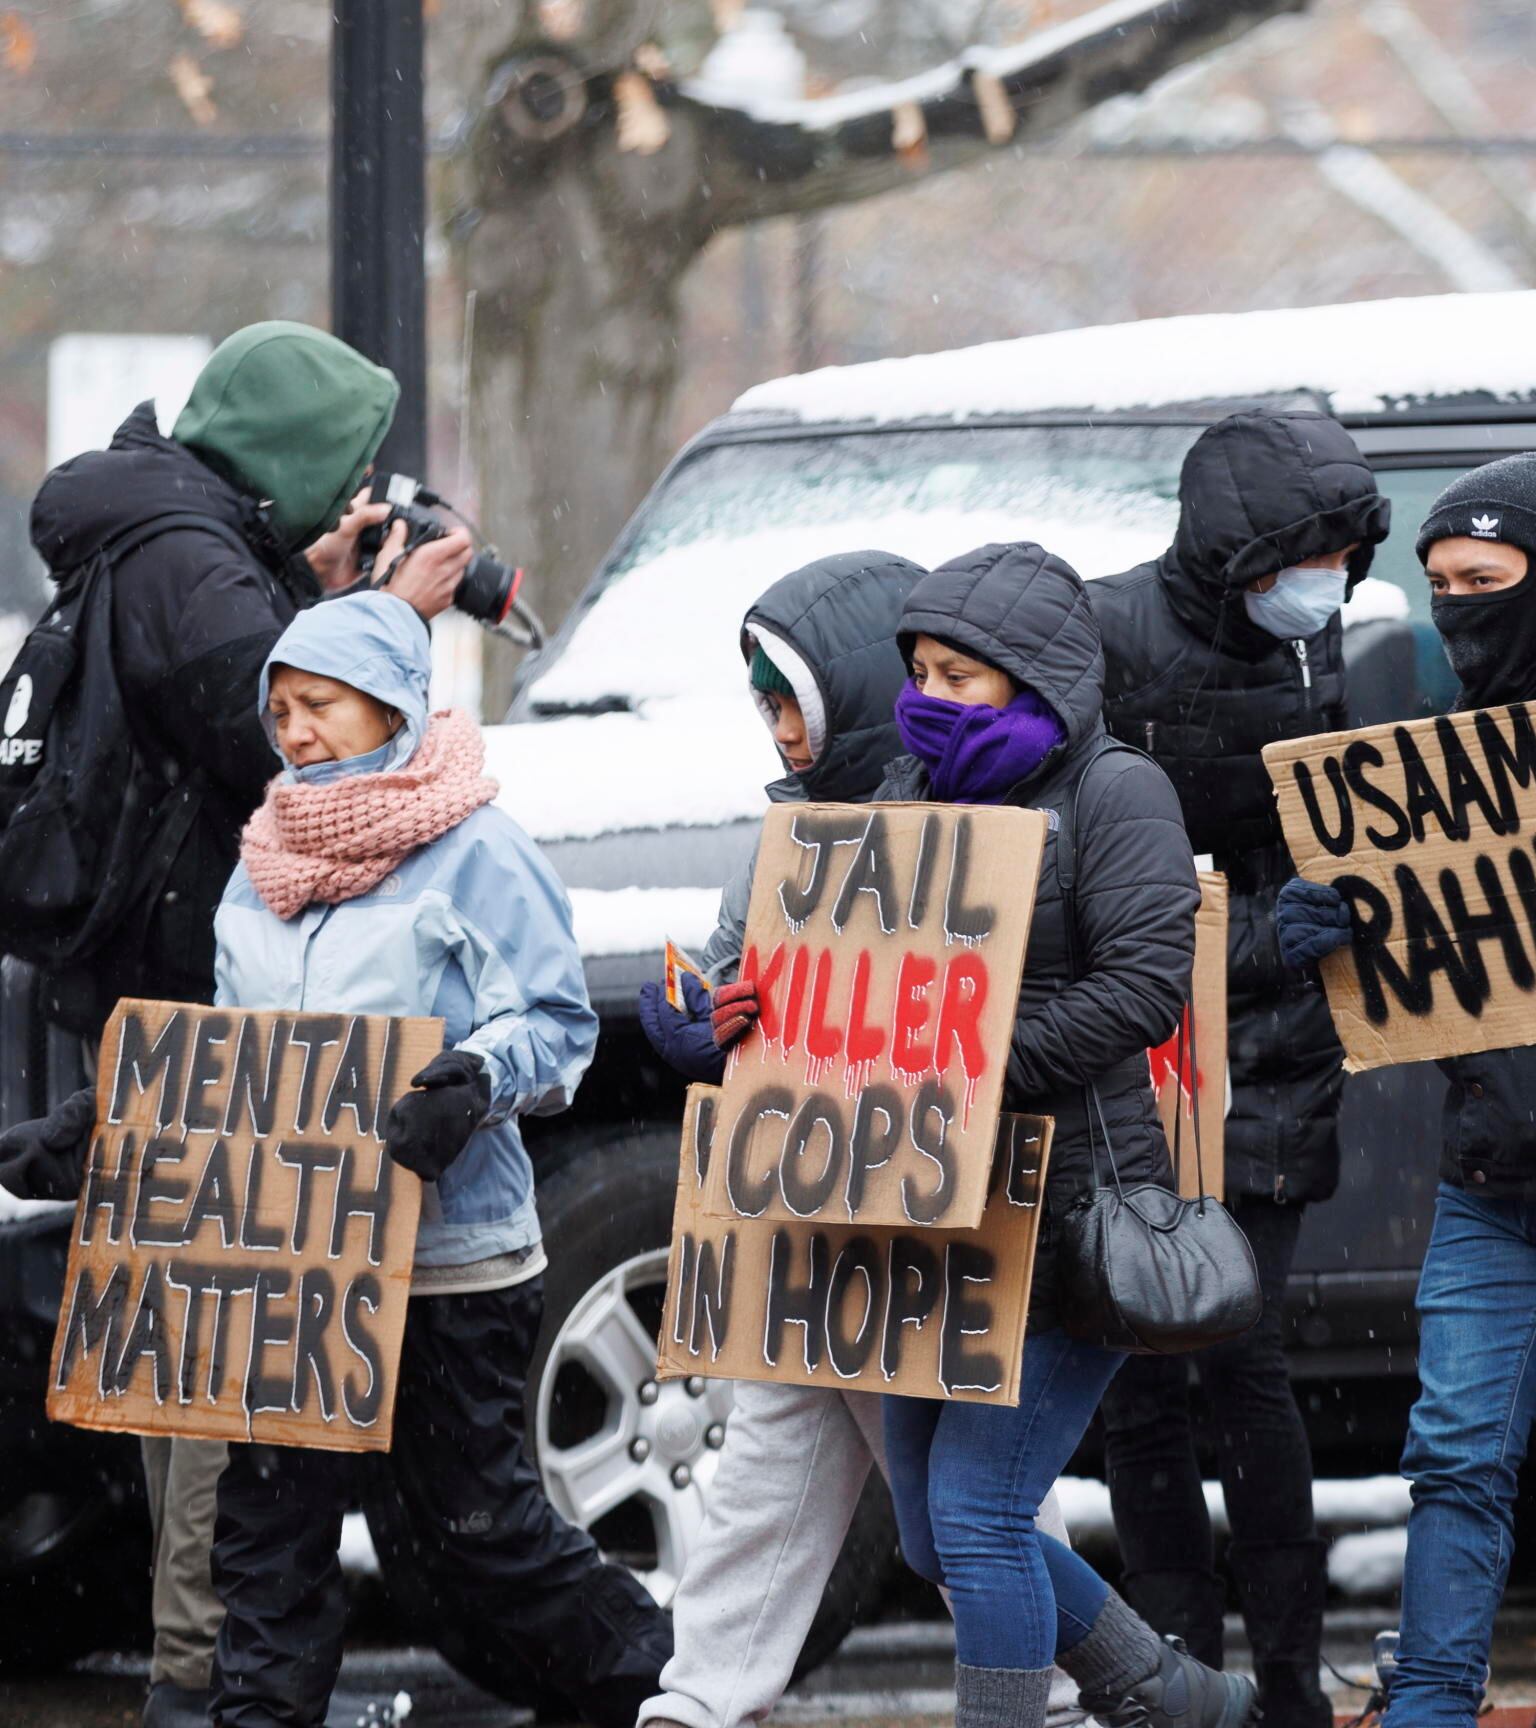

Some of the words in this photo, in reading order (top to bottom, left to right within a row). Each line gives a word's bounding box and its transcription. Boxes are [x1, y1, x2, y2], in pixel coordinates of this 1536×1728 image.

[778, 810, 996, 947] JAIL
[733, 942, 989, 1112] KILLER
[79, 1130, 392, 1266] HEALTH
[727, 1083, 959, 1224] COPS
[55, 1260, 384, 1430] MATTERS
[672, 1231, 737, 1363] IN
[763, 1231, 1004, 1398] HOPE
